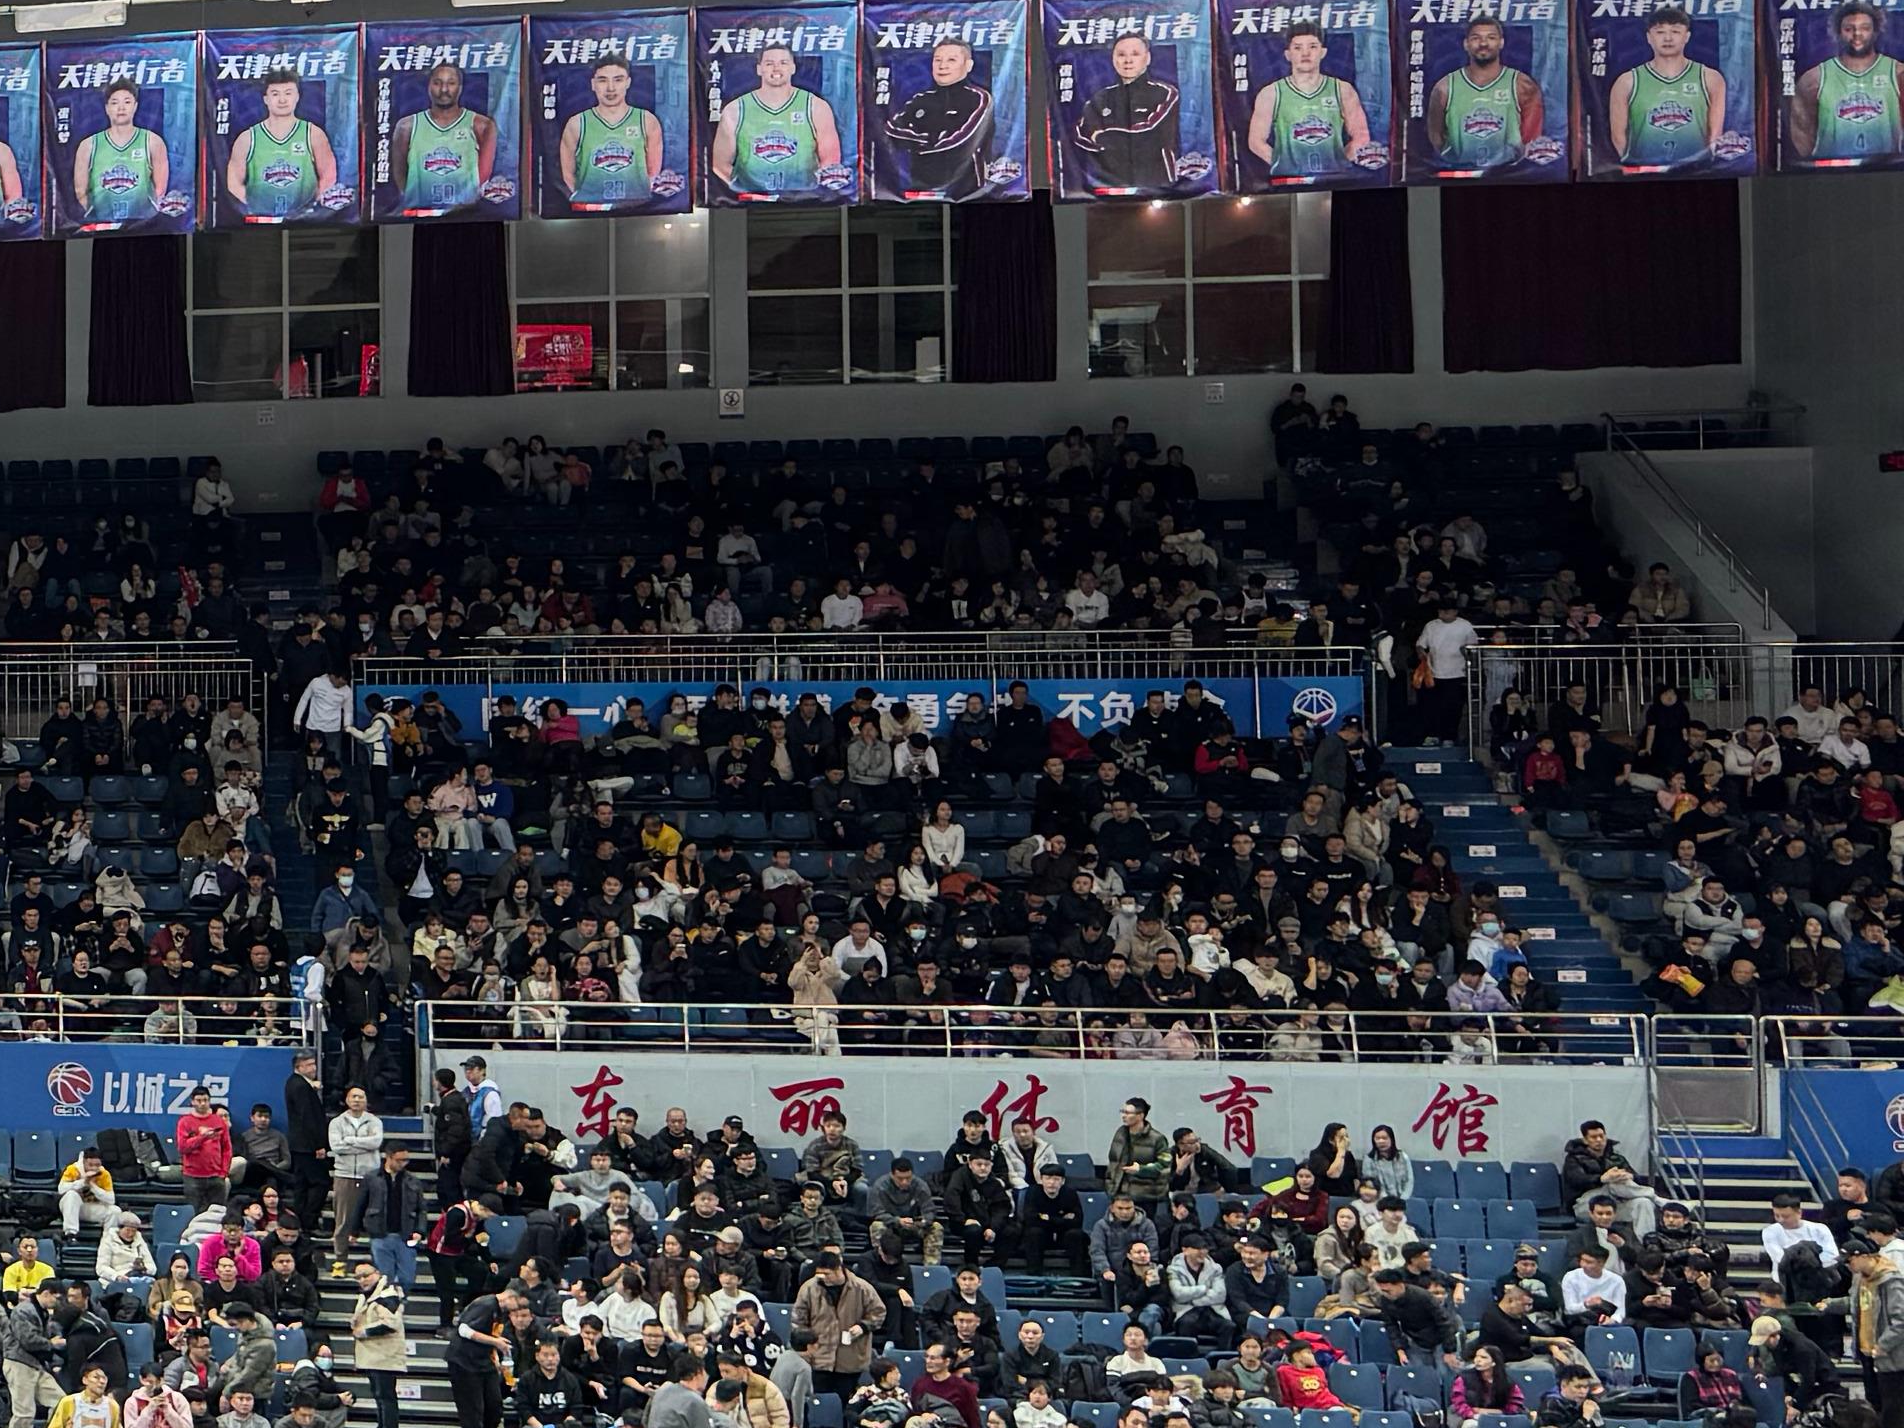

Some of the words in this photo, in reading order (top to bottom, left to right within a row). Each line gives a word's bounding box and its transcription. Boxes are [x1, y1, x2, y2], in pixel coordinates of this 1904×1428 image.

[103, 1071, 230, 1115] 以城之名
[571, 1064, 1499, 1158] 东丽体育馆
